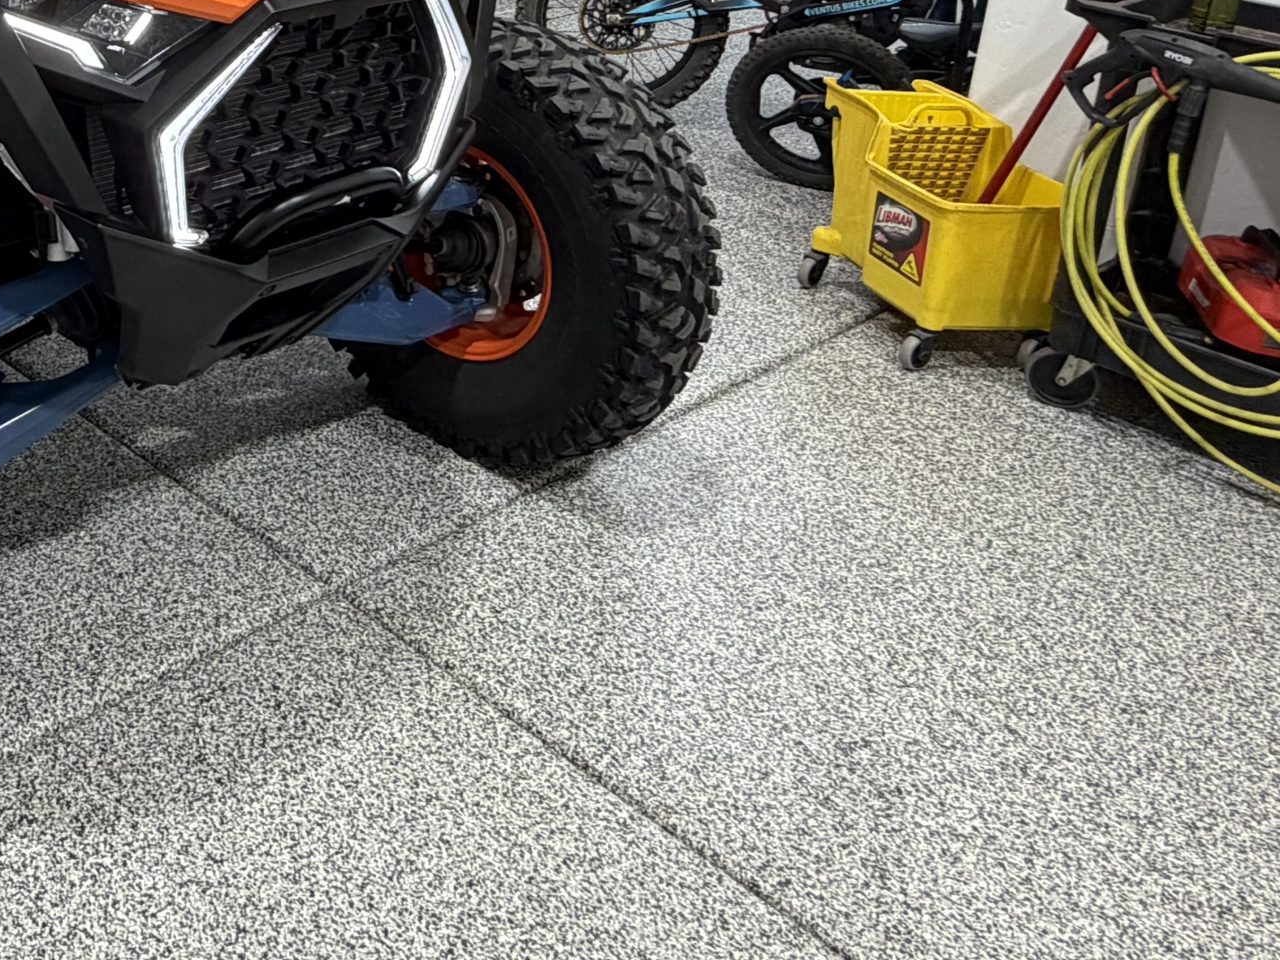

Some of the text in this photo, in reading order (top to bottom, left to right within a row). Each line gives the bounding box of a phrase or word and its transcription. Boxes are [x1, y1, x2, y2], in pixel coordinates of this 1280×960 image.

[808, 2, 841, 16] VENTUS
[1164, 49, 1194, 65] RYOBI
[876, 205, 914, 229] LIBMAN
